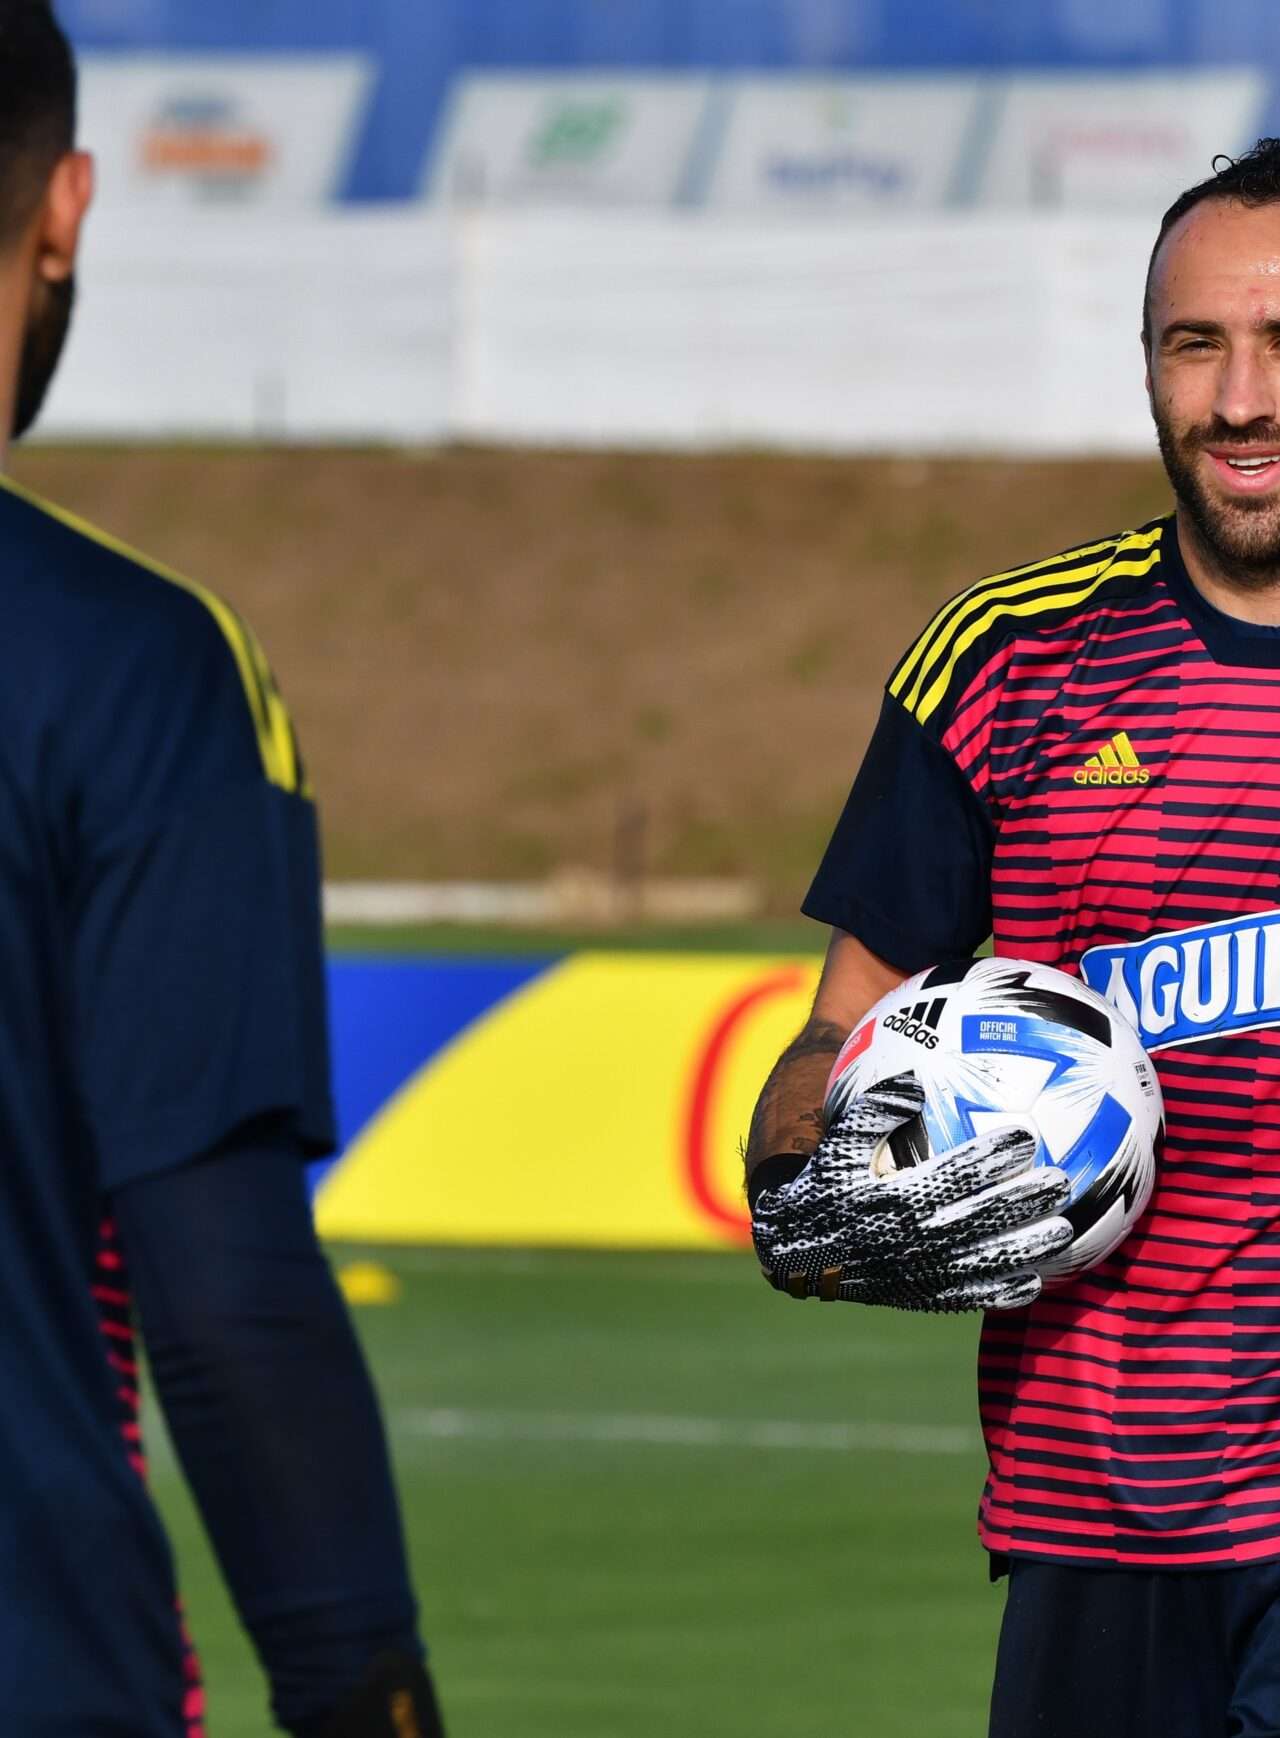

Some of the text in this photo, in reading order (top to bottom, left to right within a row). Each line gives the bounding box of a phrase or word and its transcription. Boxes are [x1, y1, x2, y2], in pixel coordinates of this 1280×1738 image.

[1073, 766, 1151, 785] adidas
[883, 1015, 940, 1050] adidas
[980, 1021, 1018, 1034] OFFICIAL
[979, 1032, 1017, 1042] MATCH BALL
